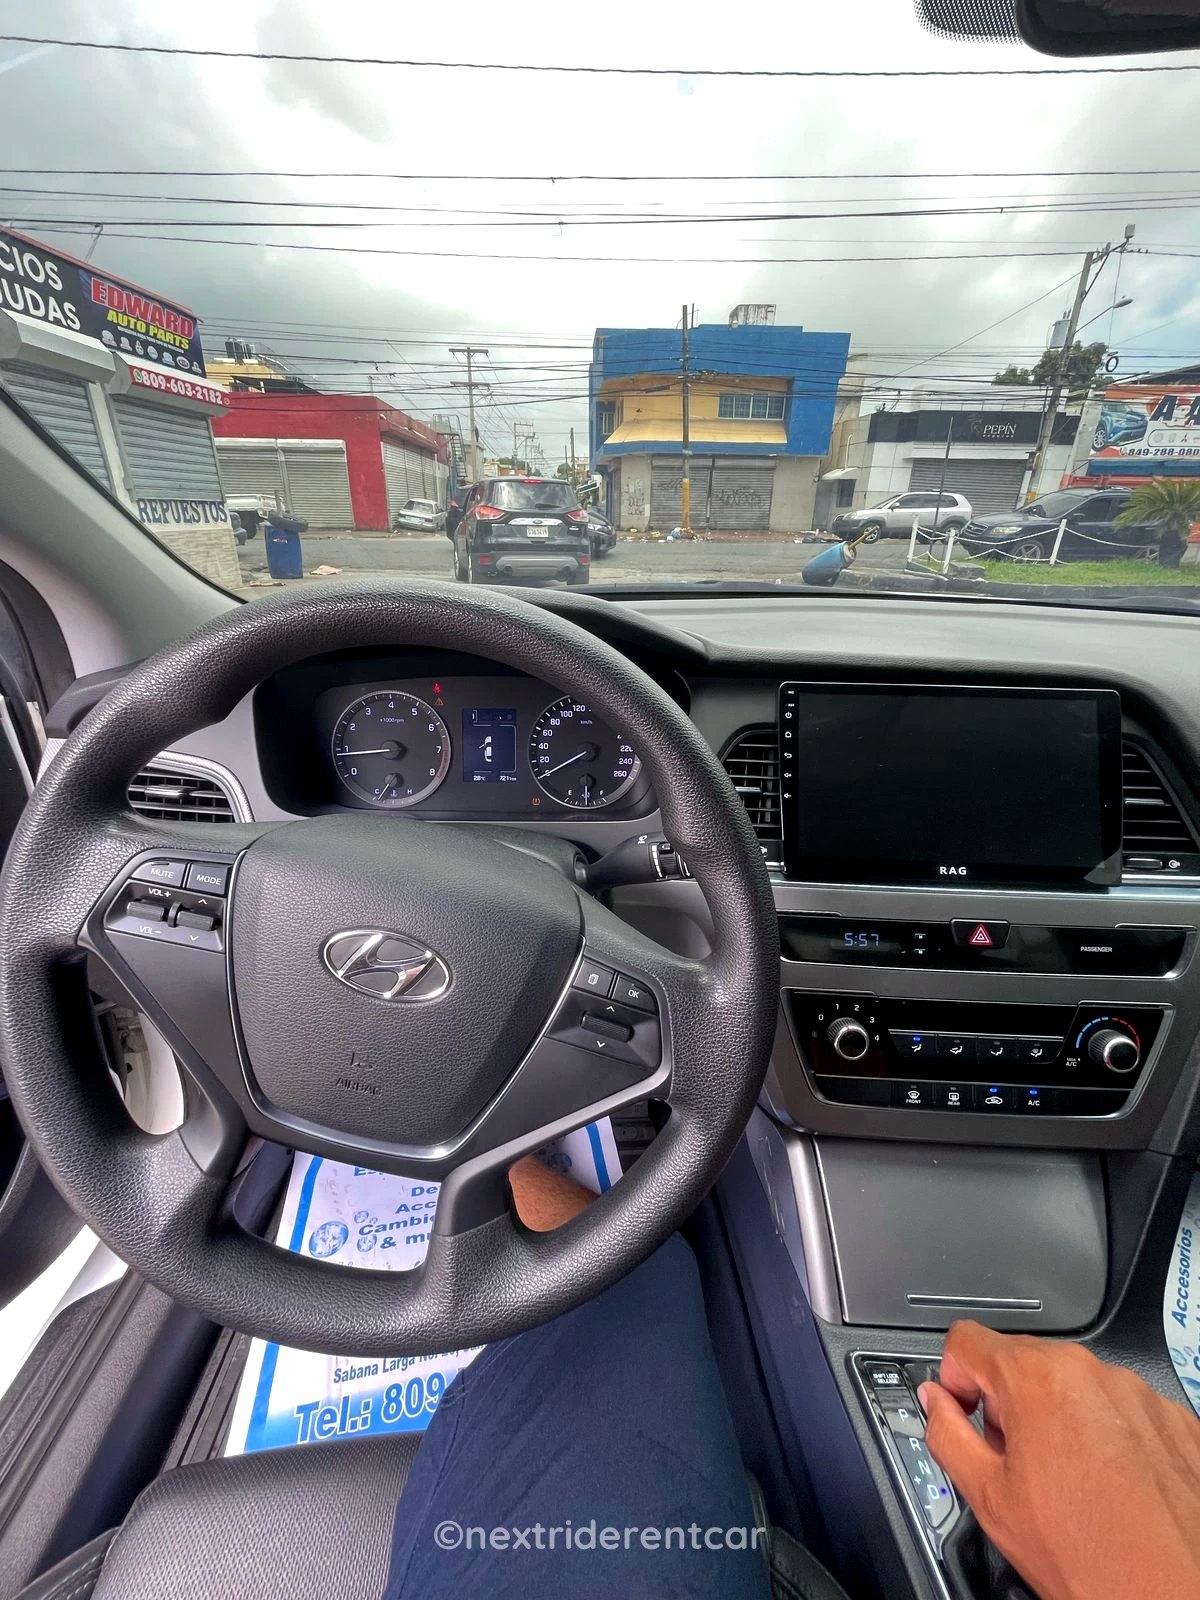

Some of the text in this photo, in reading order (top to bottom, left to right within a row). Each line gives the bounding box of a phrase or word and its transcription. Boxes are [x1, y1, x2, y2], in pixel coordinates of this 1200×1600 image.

[0, 278, 81, 330] UDAS
[91, 277, 194, 340] EDWARD
[107, 309, 147, 334] AUTO
[149, 325, 190, 350] PARTS
[141, 370, 223, 404] 809-603-2182
[983, 422, 1017, 435] PEPÍN
[137, 500, 229, 524] REPUESTOS
[388, 701, 395, 709] 4
[572, 704, 586, 712] 120
[365, 707, 372, 716] 3
[411, 707, 418, 716] 5
[560, 710, 573, 718] 100
[350, 723, 356, 731] 2
[428, 723, 435, 731] 6
[550, 718, 560, 726] 80
[542, 729, 553, 737] 60
[435, 745, 442, 754] 7
[538, 742, 549, 750] 40
[351, 767, 357, 775] 0
[429, 768, 436, 776] 8
[613, 770, 627, 778] 260
[150, 867, 175, 879] MUTE
[939, 866, 967, 875] RAG
[196, 874, 222, 886] MODE
[844, 932, 880, 947] 5:57
[628, 989, 640, 999] OK
[854, 1004, 860, 1012] 2
[1171, 1227, 1192, 1329] Accesorios
[333, 1362, 379, 1384] Sabana
[382, 1354, 415, 1373] Larga
[294, 1371, 448, 1444] Tel.: 809
[898, 1408, 909, 1423] P
[909, 1437, 923, 1452] R
[918, 1460, 932, 1475] N
[927, 1484, 940, 1500] D
